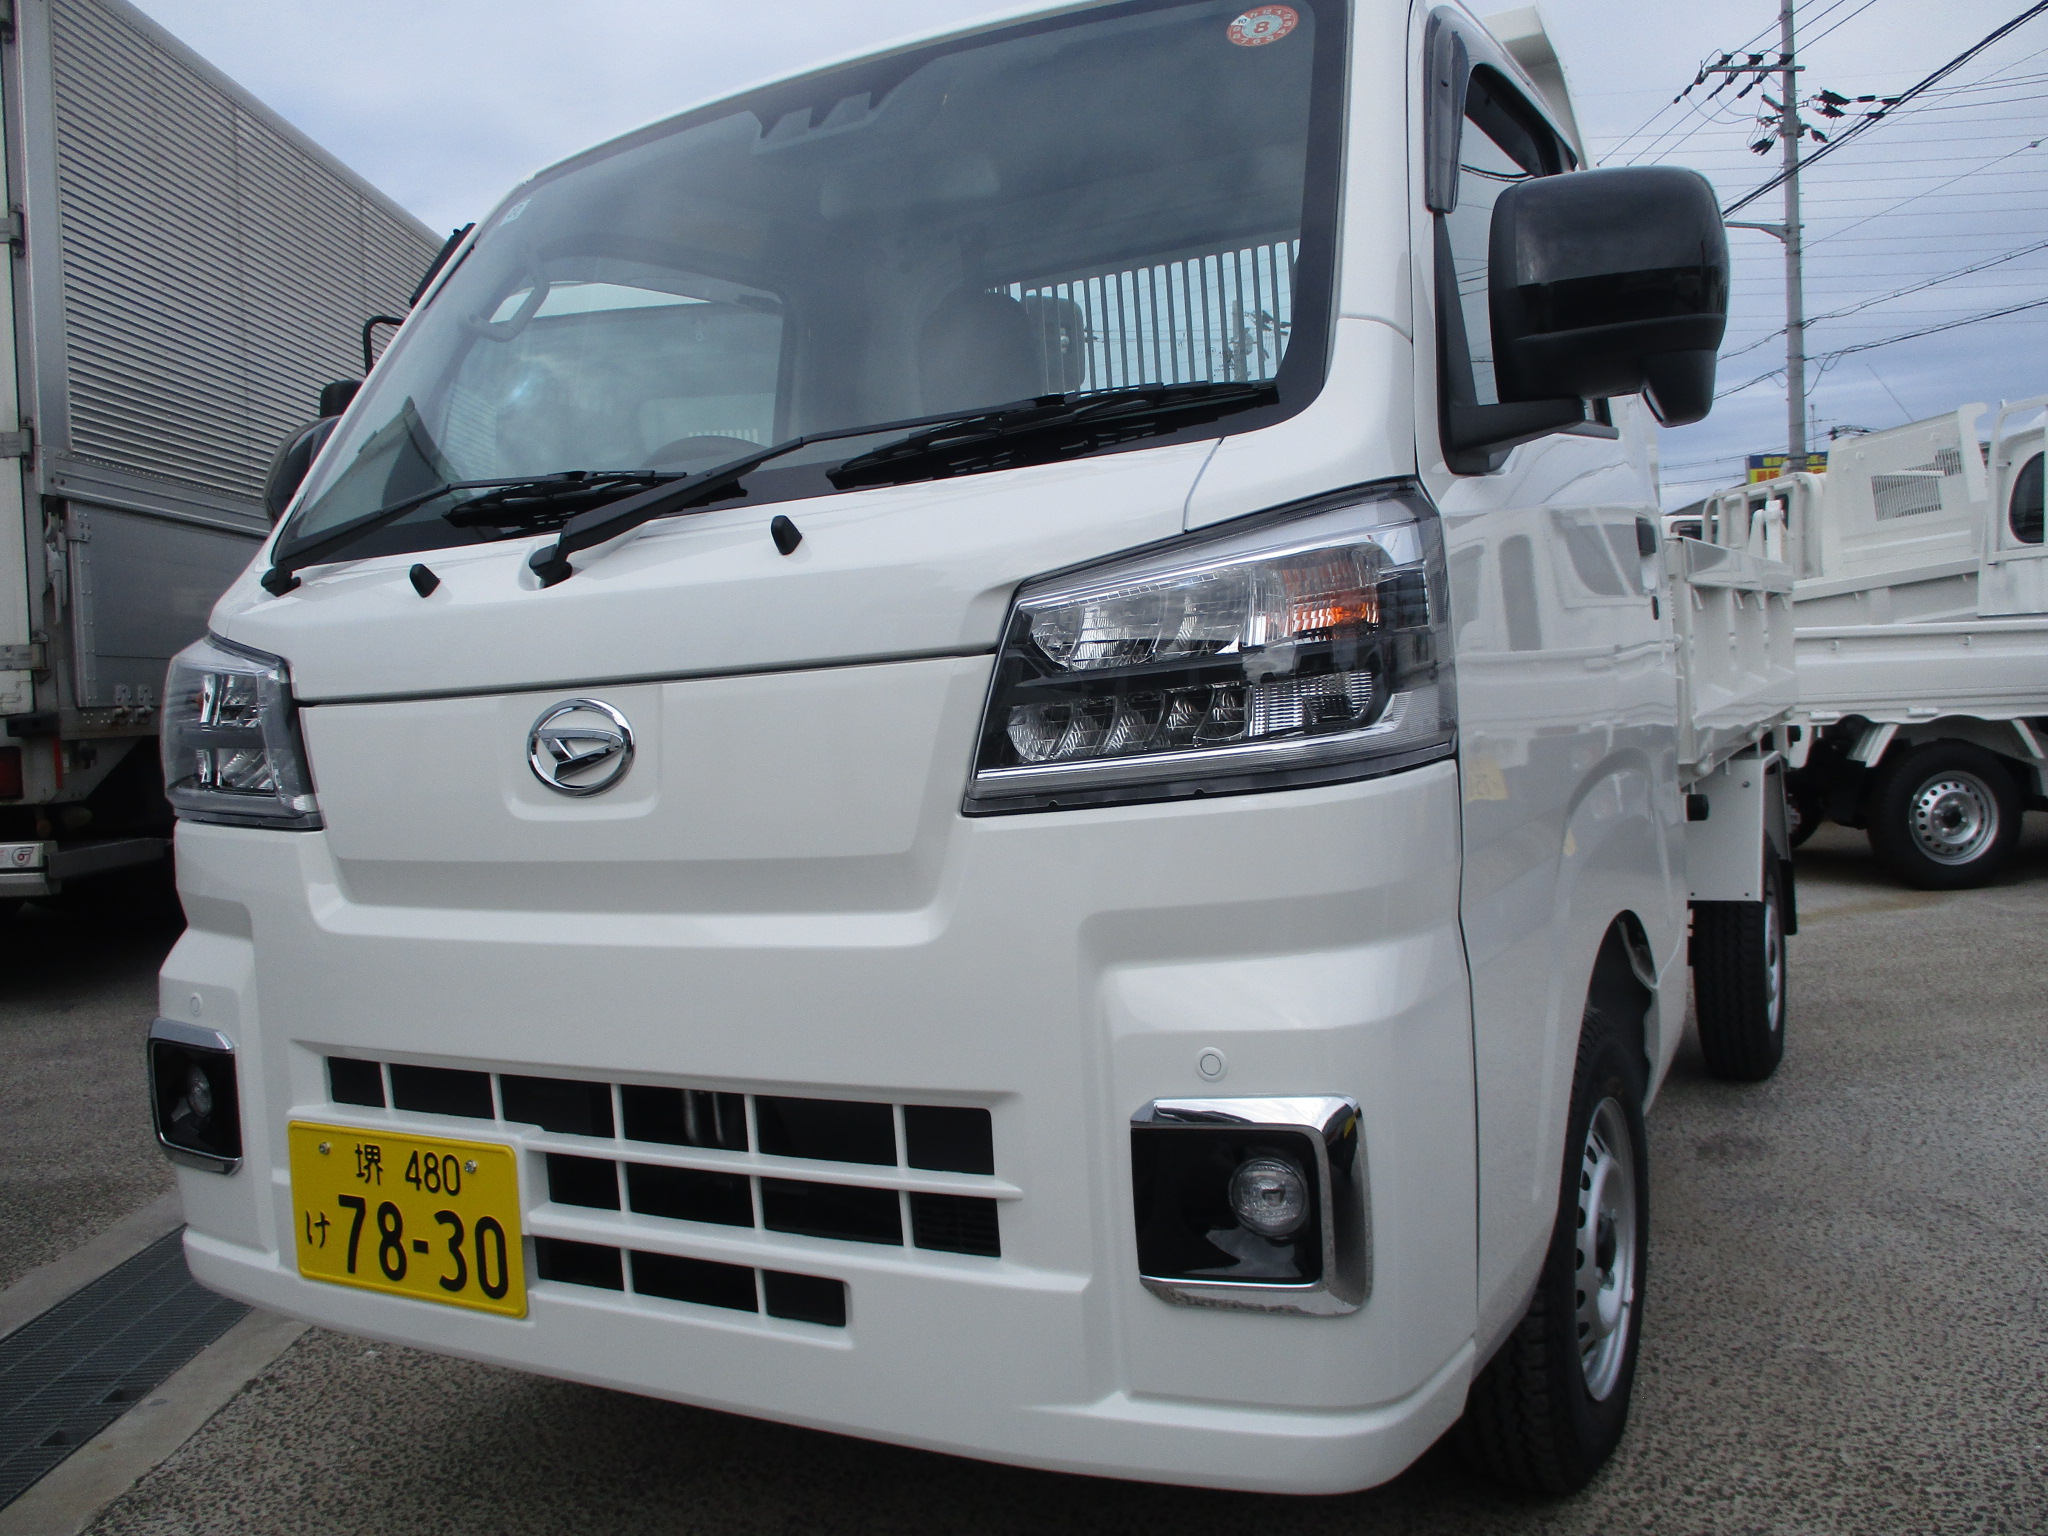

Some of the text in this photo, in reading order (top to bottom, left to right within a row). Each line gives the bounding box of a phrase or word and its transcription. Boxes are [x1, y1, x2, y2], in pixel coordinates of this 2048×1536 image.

[1253, 21, 1270, 33] 8
[355, 1143, 462, 1197] 堺 480
[305, 1194, 509, 1299] け 78-30
